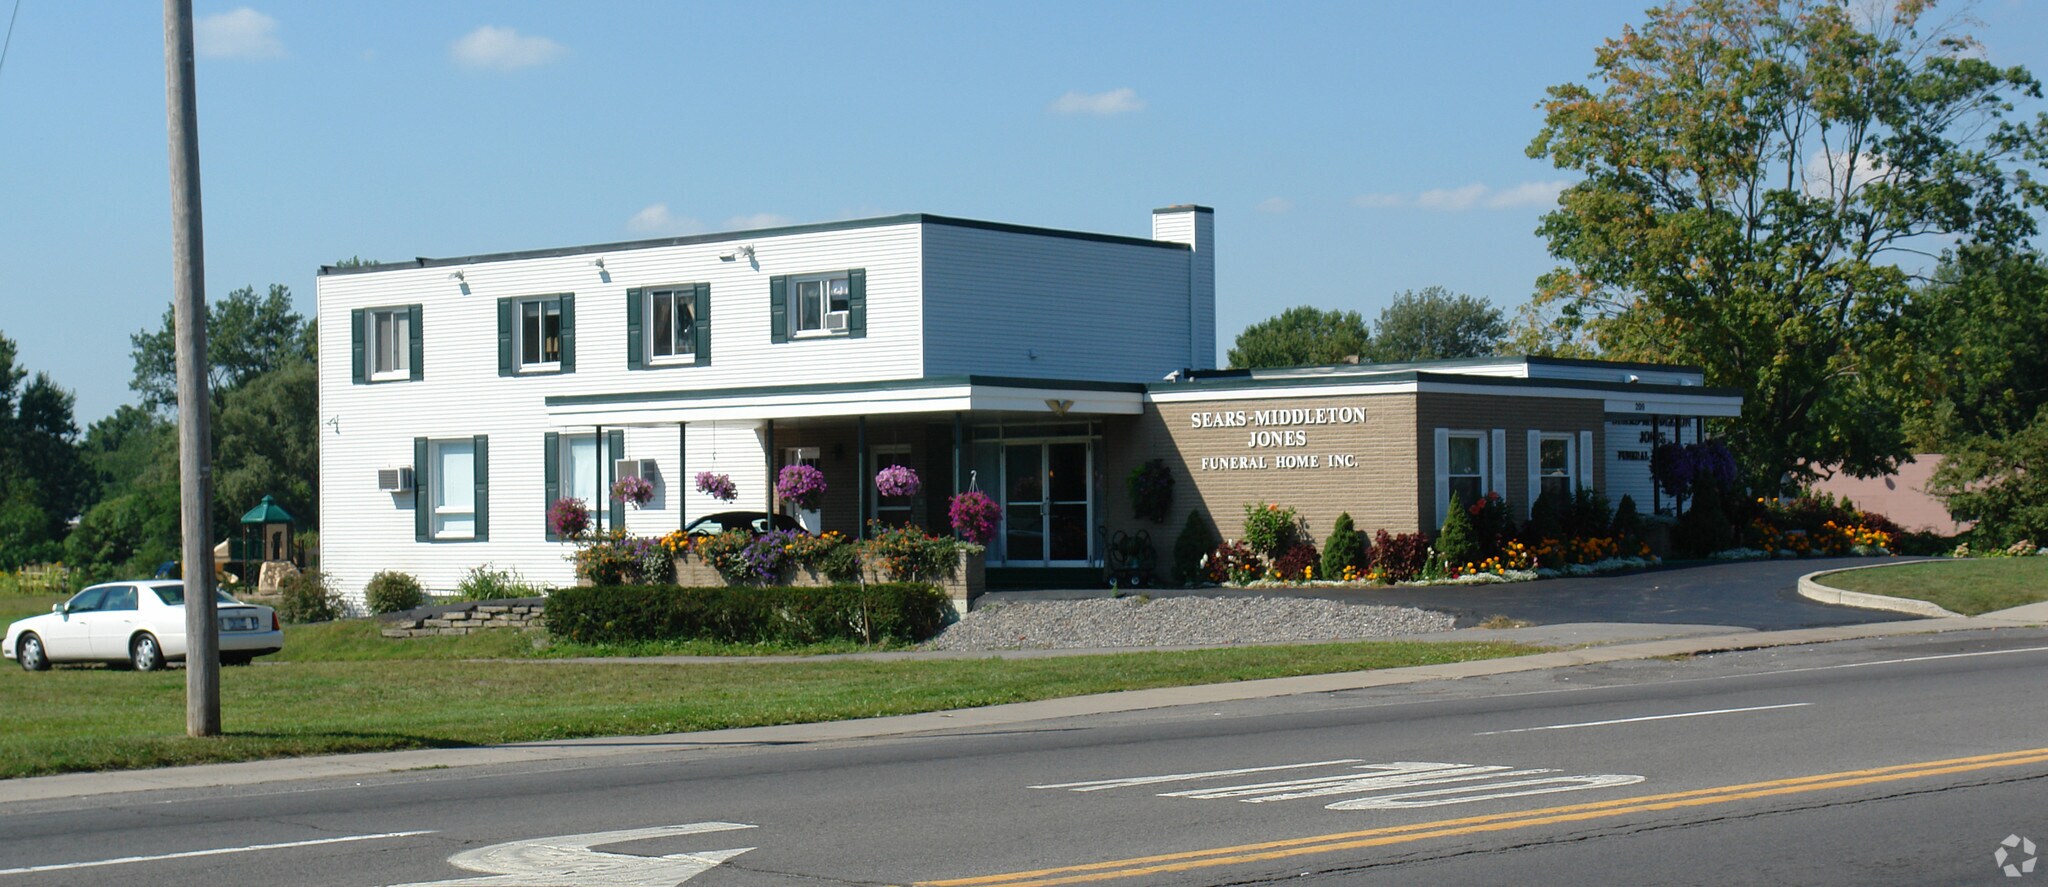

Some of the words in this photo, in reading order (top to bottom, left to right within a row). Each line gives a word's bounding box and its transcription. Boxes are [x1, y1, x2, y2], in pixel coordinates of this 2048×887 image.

[1191, 407, 1367, 428] SEARS-MIDDLETON
[1248, 430, 1307, 448] JONES
[1201, 456, 1268, 470] FUNERAL
[1276, 455, 1320, 469] HOME
[1328, 454, 1359, 468] INC.
[1025, 759, 1647, 810] ONLY
